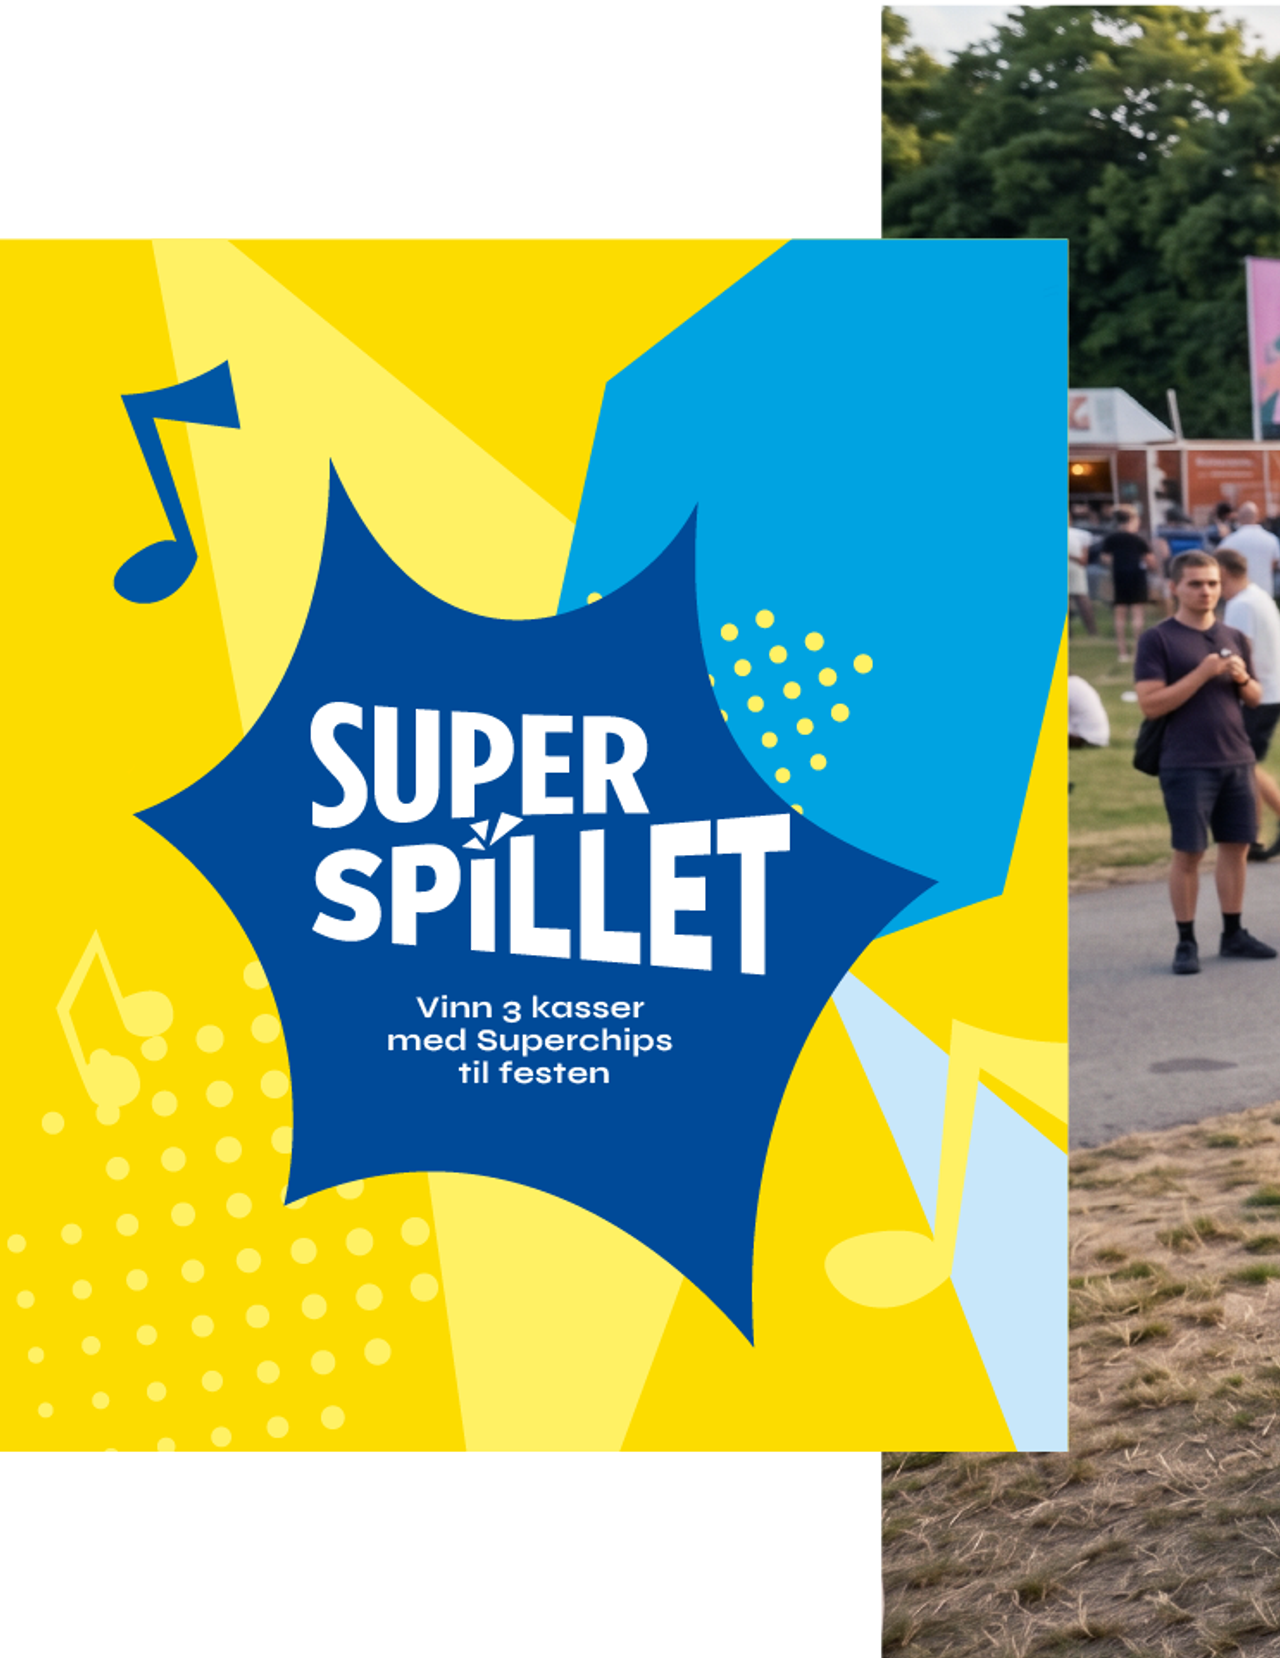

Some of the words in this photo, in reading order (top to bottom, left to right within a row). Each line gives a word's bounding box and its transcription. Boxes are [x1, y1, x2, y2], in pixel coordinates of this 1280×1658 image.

[310, 701, 650, 829] SUPER
[312, 812, 791, 976] SPILLET
[416, 996, 493, 1019] Vinn
[502, 1001, 522, 1023] 3
[532, 995, 645, 1019] kasser
[387, 1028, 467, 1052] med
[477, 1028, 674, 1057] Superchips
[458, 1061, 489, 1084] til
[499, 1060, 611, 1084] festen
